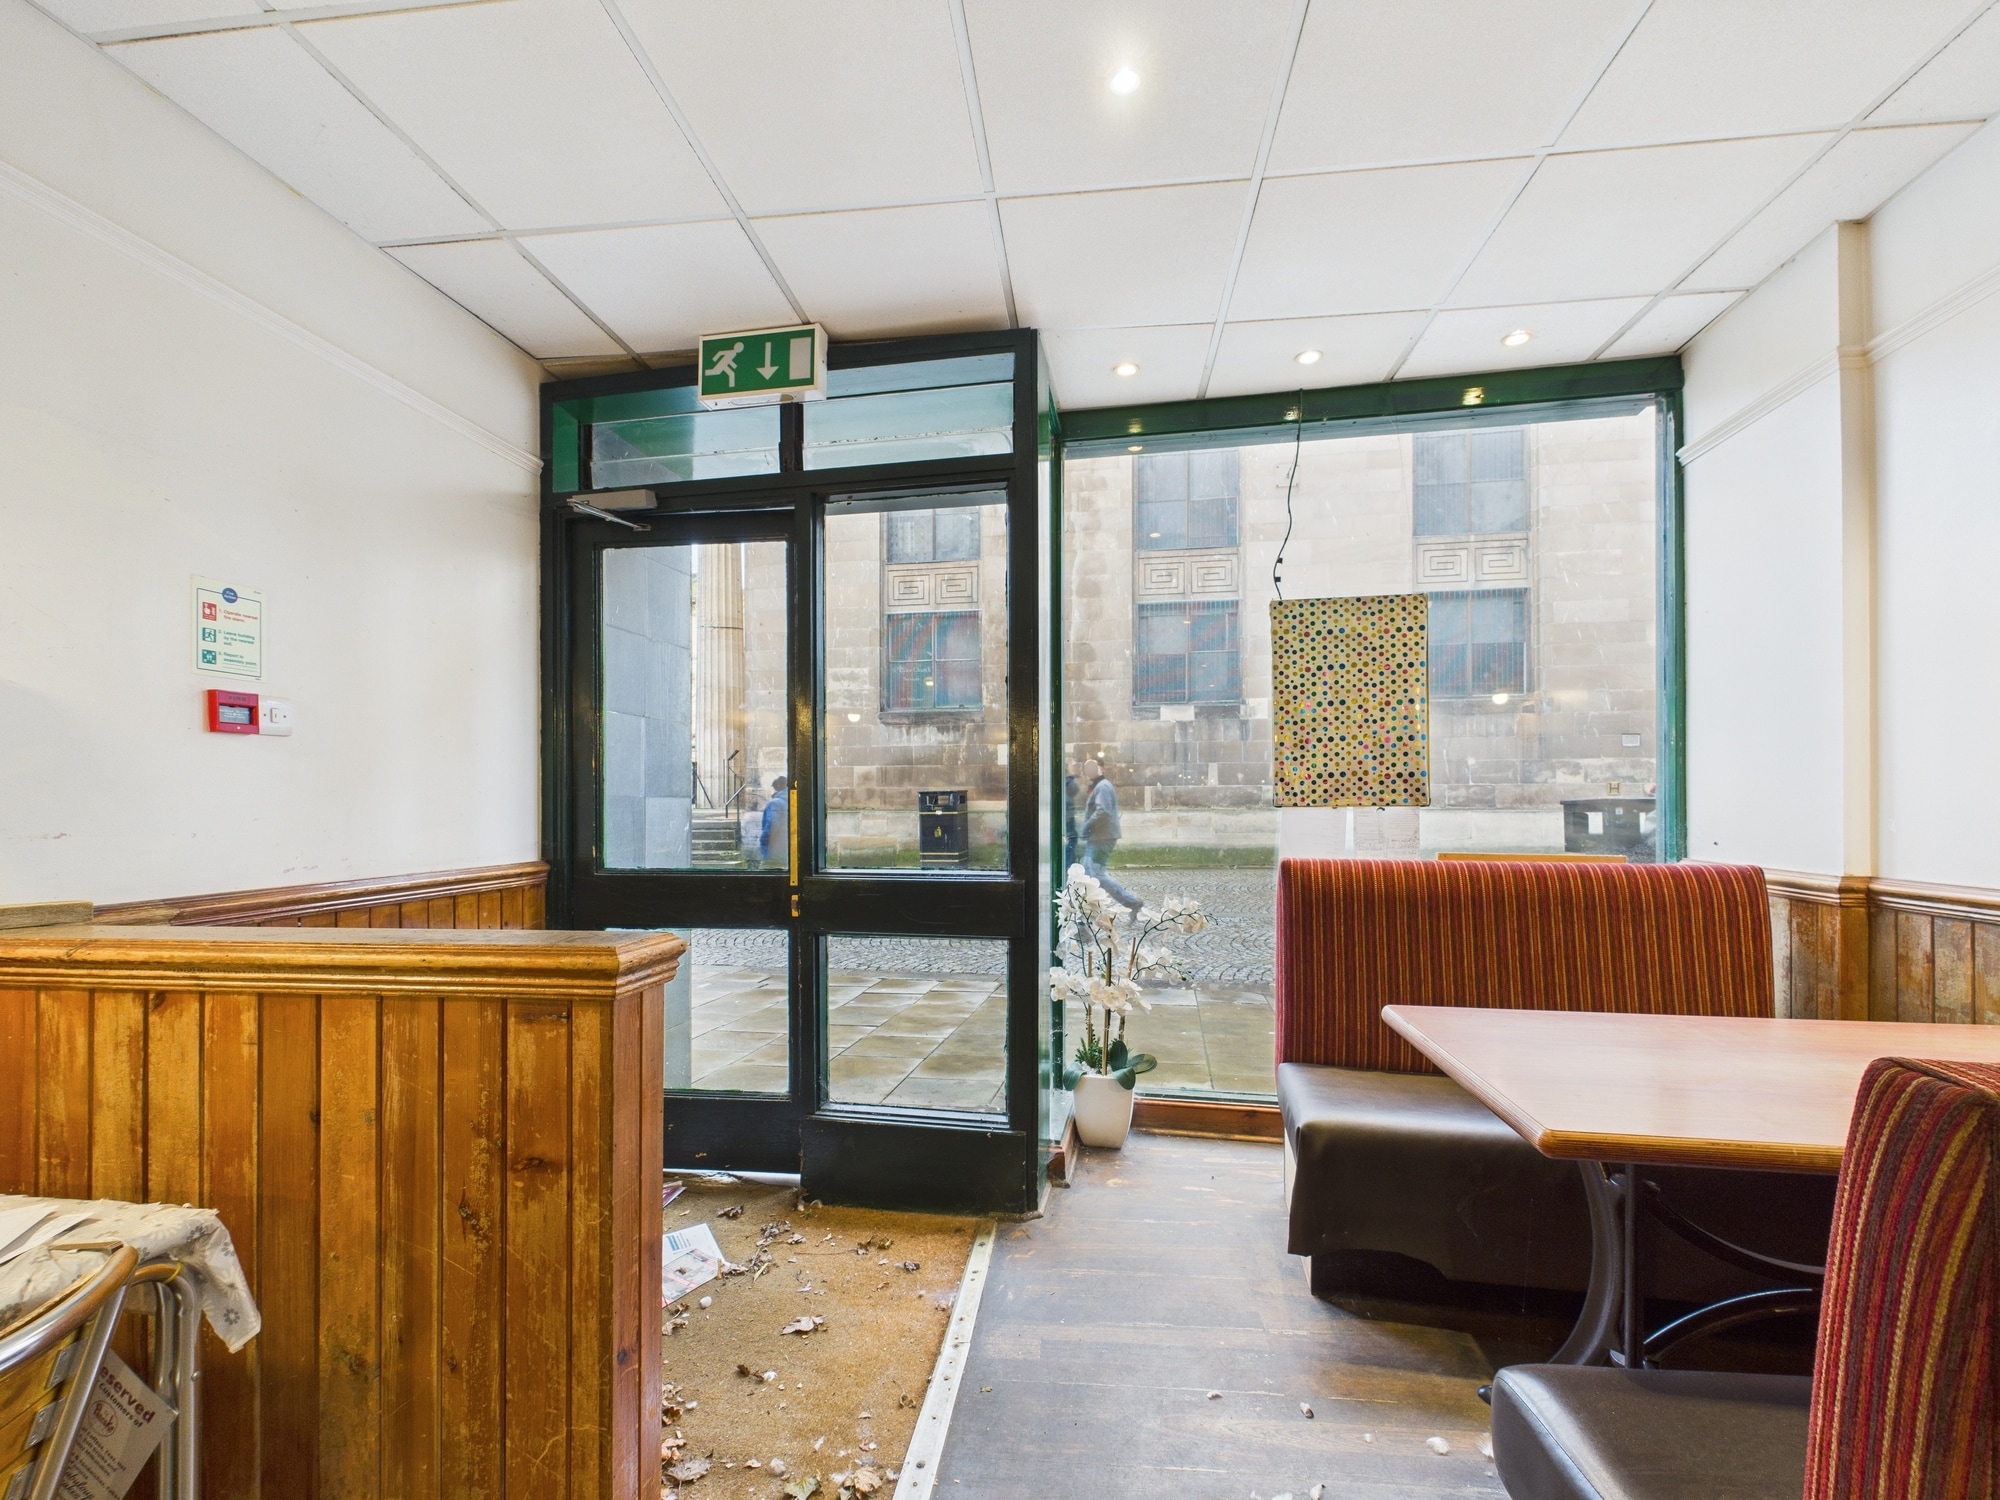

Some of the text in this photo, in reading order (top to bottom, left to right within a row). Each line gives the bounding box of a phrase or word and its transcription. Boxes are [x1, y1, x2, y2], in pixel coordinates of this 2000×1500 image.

[99, 1383, 137, 1422] Customers
[134, 1417, 143, 1428] of
[100, 1367, 155, 1424] eserved
